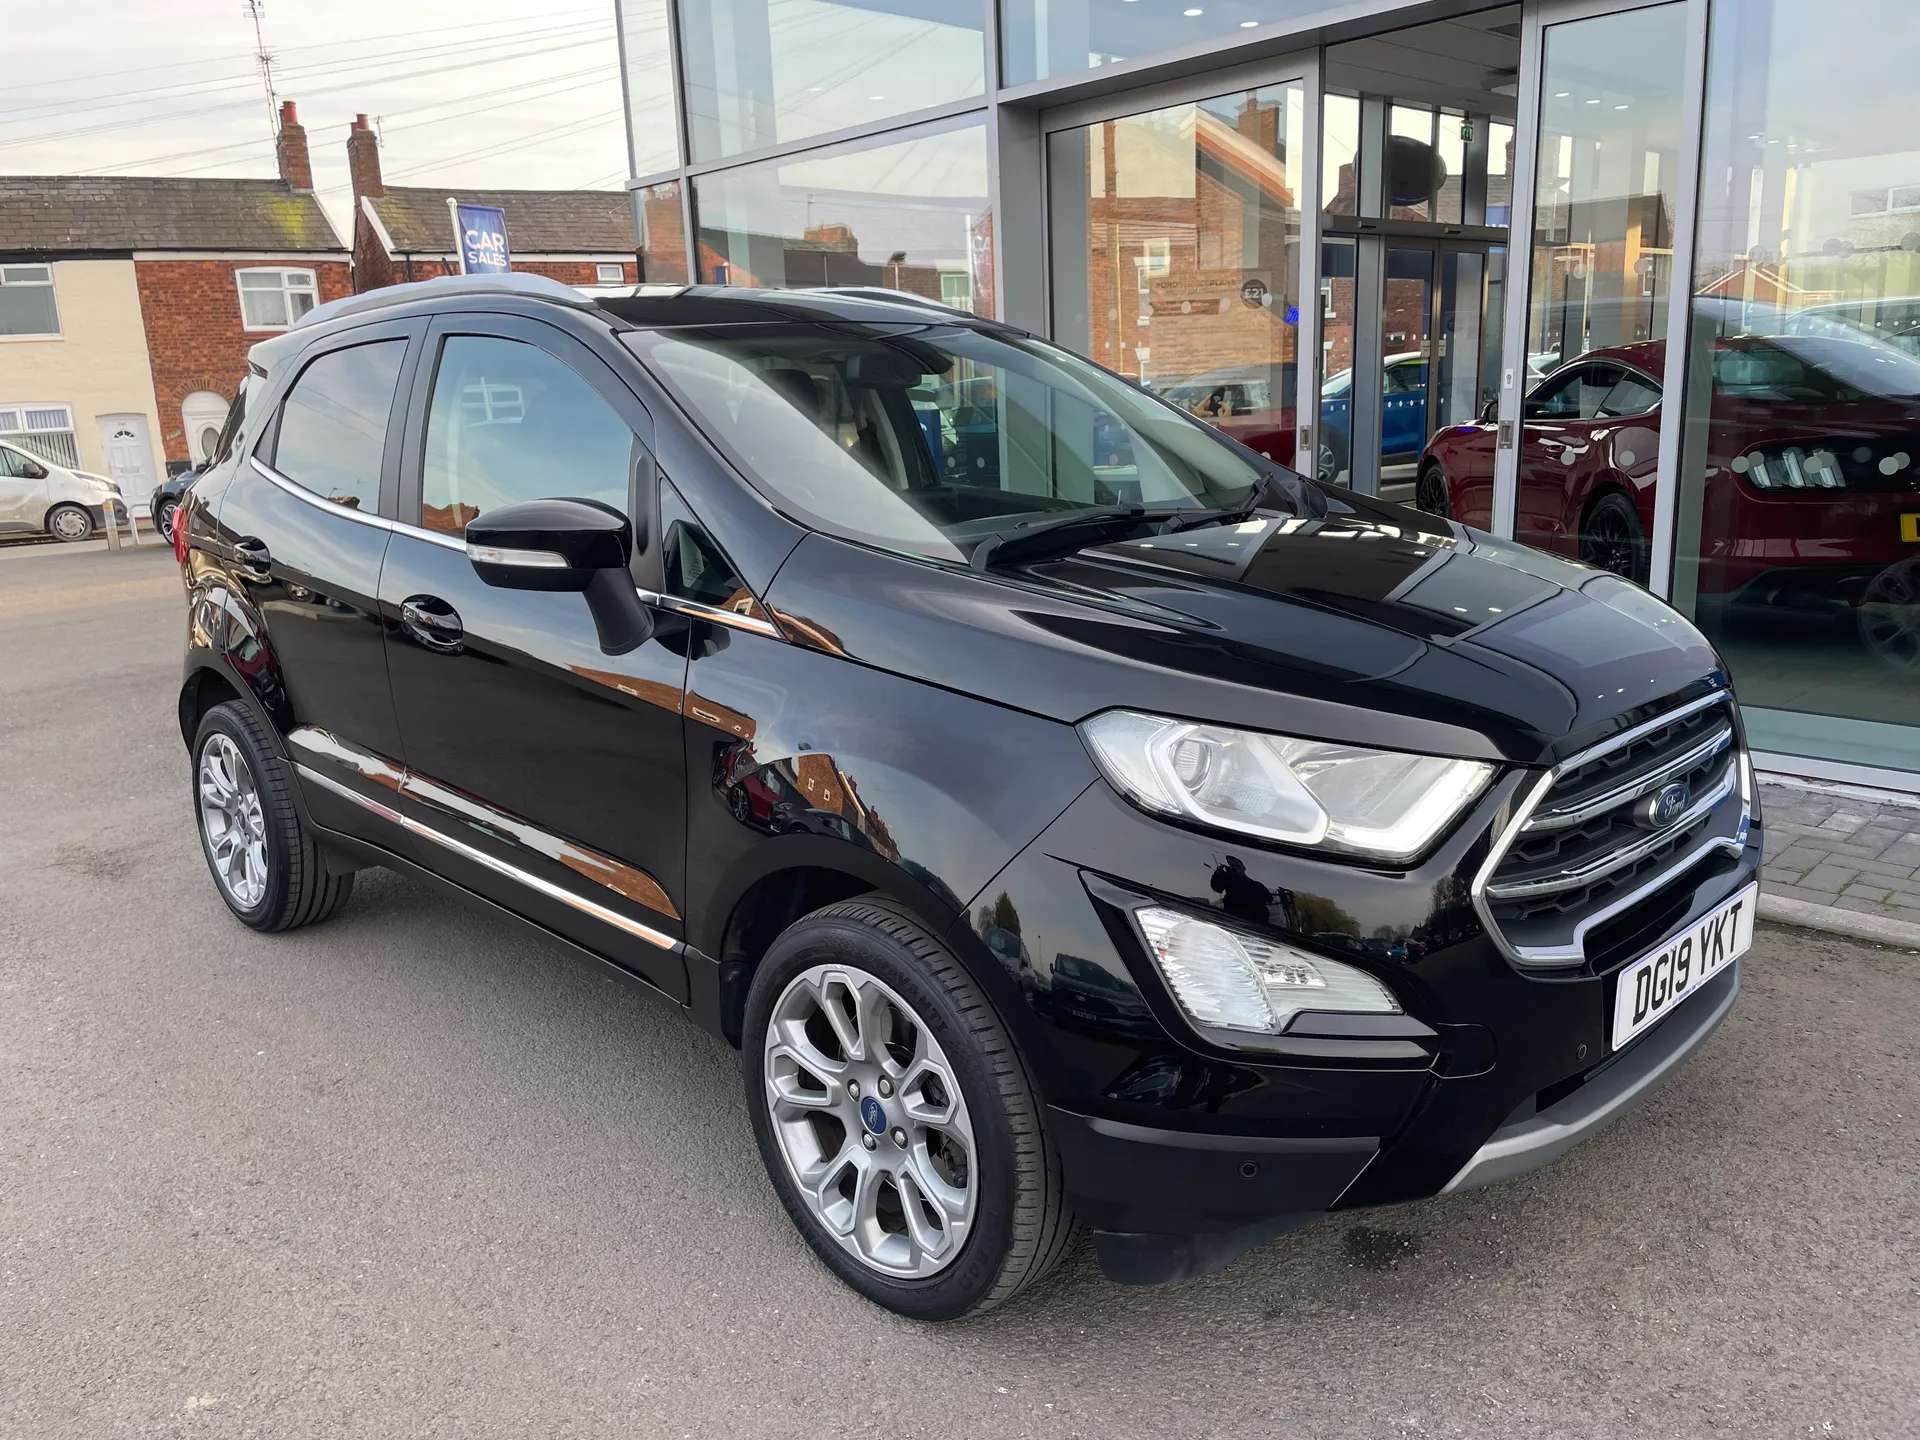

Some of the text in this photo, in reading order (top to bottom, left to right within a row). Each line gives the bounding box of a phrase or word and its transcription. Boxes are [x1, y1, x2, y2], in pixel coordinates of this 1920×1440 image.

[465, 229, 505, 252] CAR
[468, 251, 507, 267] SALES
[1632, 900, 1743, 1026] DG19 YKT
